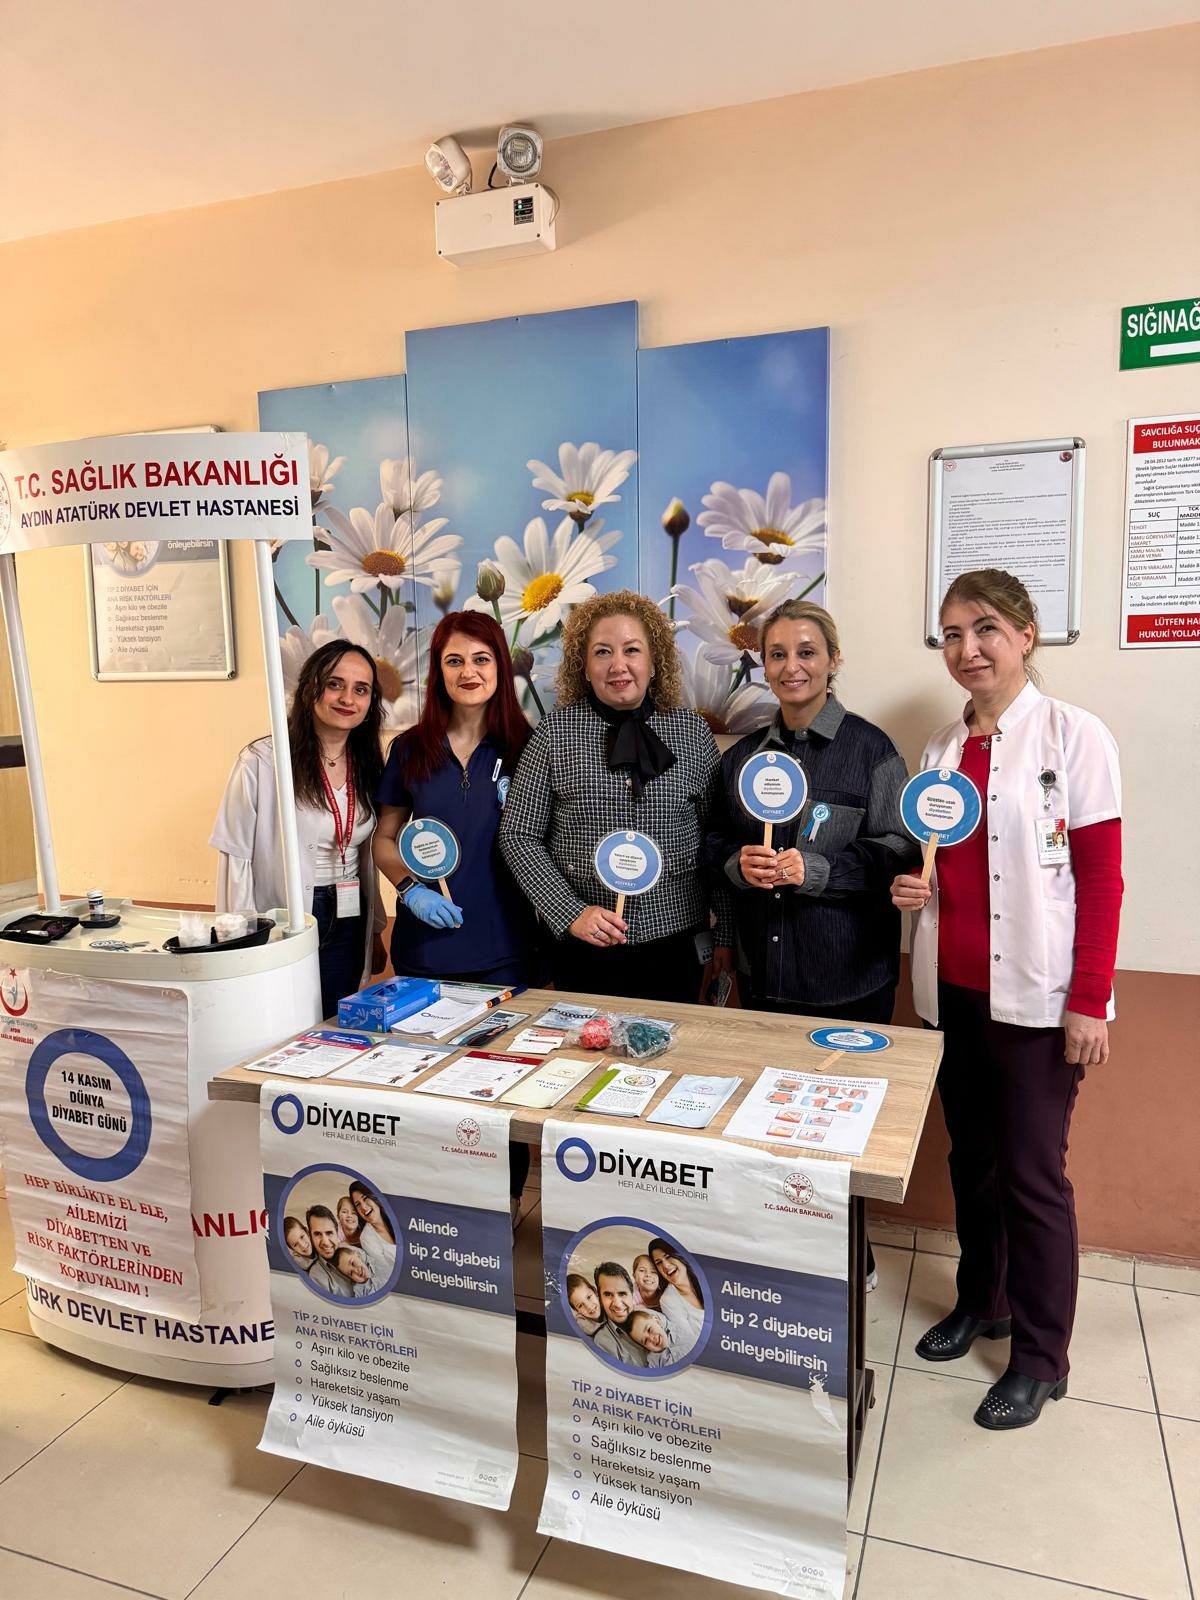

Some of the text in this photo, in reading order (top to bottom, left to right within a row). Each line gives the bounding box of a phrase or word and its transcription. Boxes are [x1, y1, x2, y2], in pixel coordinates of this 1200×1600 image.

[1127, 301, 1200, 337] SIĞINAĞ
[1141, 425, 1182, 437] SAVCILIĞA
[14, 453, 298, 499] T.C. SAĞLIK BAKANLIĞI
[21, 496, 299, 528] AYDIN ATATÜRK DEVLET HASTANESİ
[1139, 629, 1170, 638] HUKUKİ
[1154, 616, 1200, 626] LÜTFEN HA
[61, 1070, 112, 1091] 14 KASIM
[69, 1090, 105, 1109] DÜNYA
[52, 1104, 127, 1132] DİYABET GÜNÜ
[306, 1102, 400, 1136] DİYABET
[451, 1147, 468, 1155] SAĞLIK
[469, 1150, 497, 1158] BAKANLIĞI
[599, 1148, 714, 1189] DİYABET
[24, 1173, 168, 1223] HEP BİRLİKTE EL ELE,
[618, 1180, 634, 1189] HER
[66, 1203, 128, 1231] AİLEMİZİ
[408, 1218, 458, 1237] Ailende
[776, 1205, 798, 1214] SAĞLIK
[799, 1208, 833, 1220] BAKANLIĞI
[46, 1217, 151, 1256] DİYABETTEN VE
[27, 1231, 183, 1286] RİSK FAKTÖRLERİNDEN
[409, 1242, 500, 1269] tip 2 diyabeti
[59, 1262, 141, 1295] KORUYALIM
[411, 1266, 498, 1294] önleyebilirsin
[721, 1280, 782, 1304] Ailende
[67, 1299, 147, 1335] DEVLET
[155, 1319, 275, 1345] HASTANE
[293, 1310, 394, 1338] TİP 2 DİYABET İÇİN
[721, 1308, 832, 1343] tip 2 diyabeti
[295, 1326, 418, 1358] ANA RİSK FAKTÖRLERİ
[311, 1342, 410, 1373] Aşırı kilo ve obezite
[720, 1335, 828, 1372] önleyebilirsin
[310, 1360, 409, 1391] Sağlıksız beslenme
[311, 1377, 401, 1407] Hareketsiz yaşam
[572, 1380, 693, 1417] TİP 2 DİYABET İÇİN
[311, 1393, 394, 1423] Yüksek tansiyon
[572, 1398, 721, 1440] ANA RİSK FAKTÖRLERİ
[305, 1413, 365, 1437] Aile öyküsü
[592, 1416, 712, 1453] Aşırı kilo ve obezite
[591, 1435, 712, 1474] Sağlıksız beslenme
[591, 1454, 700, 1491] Hareketsiz yaşam
[593, 1471, 693, 1506] Yüksek tansiyon
[590, 1492, 661, 1521] Aile öyküsü
